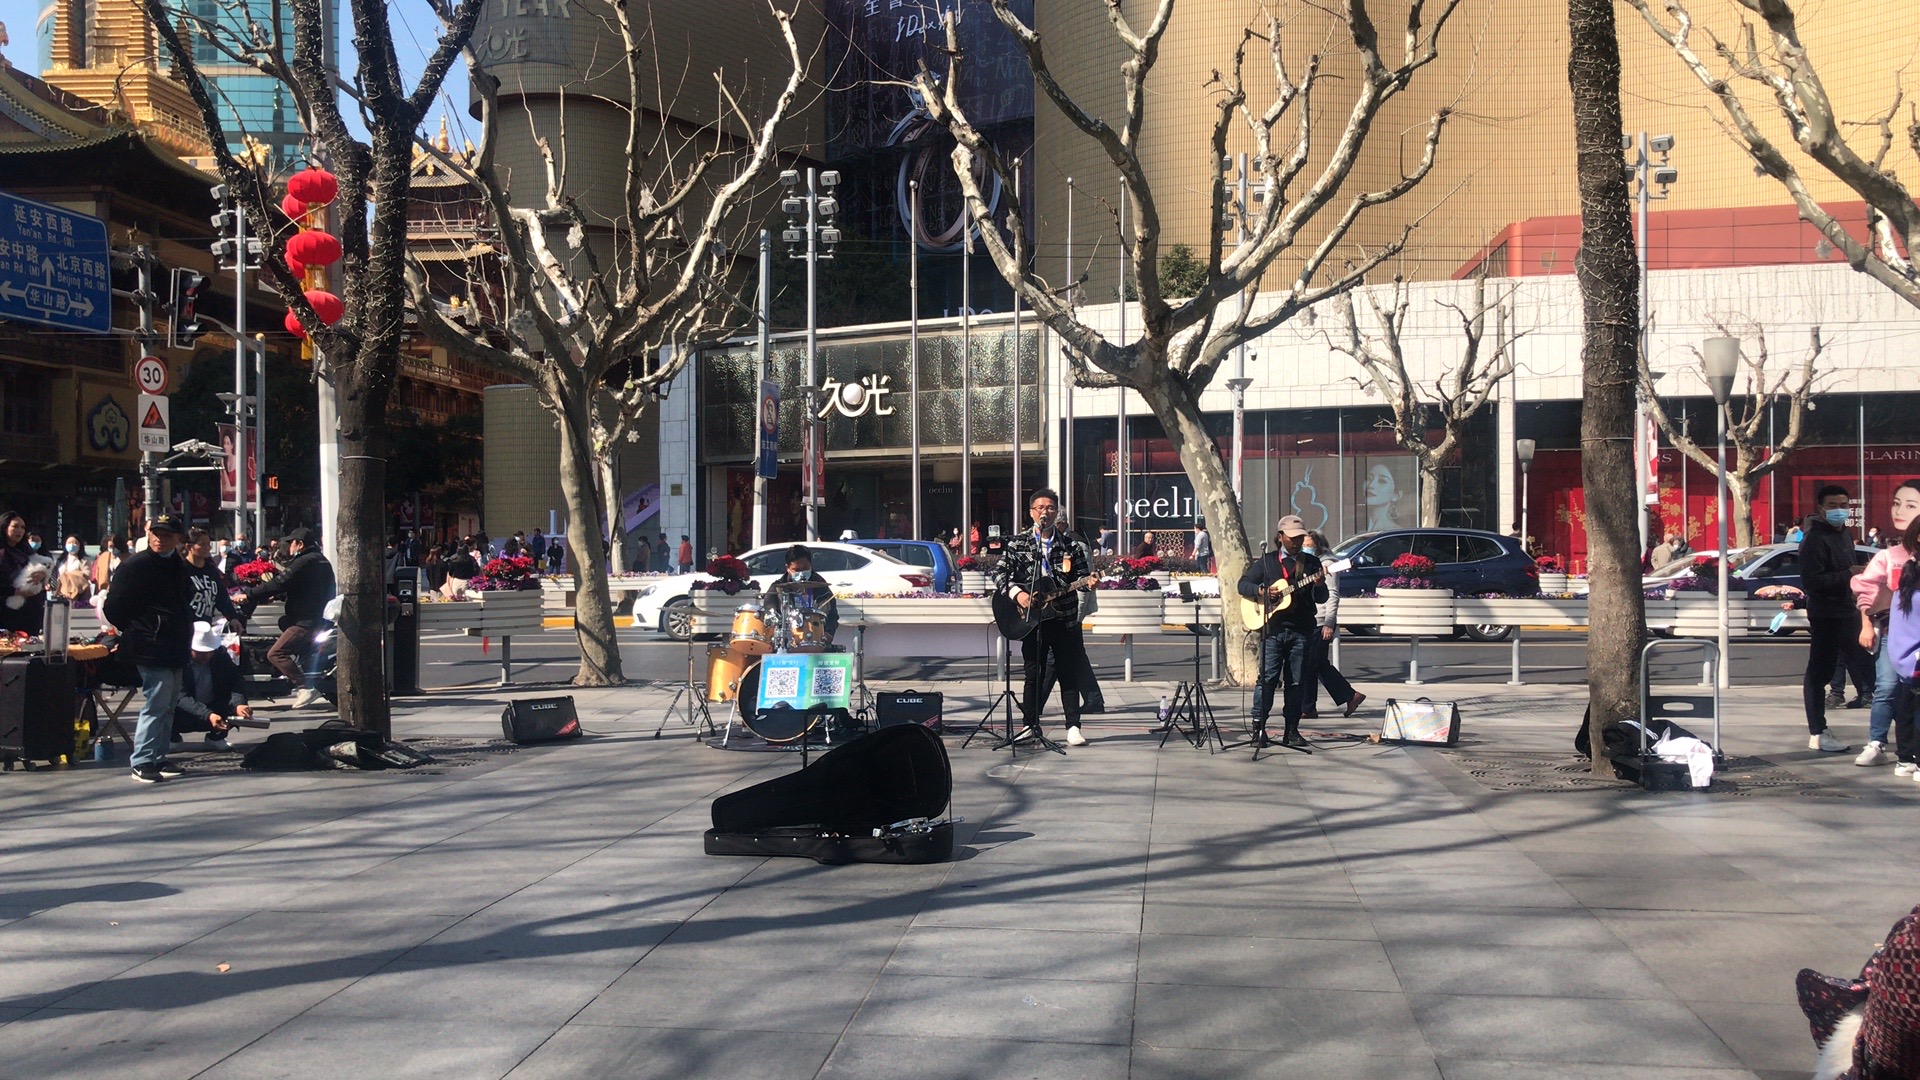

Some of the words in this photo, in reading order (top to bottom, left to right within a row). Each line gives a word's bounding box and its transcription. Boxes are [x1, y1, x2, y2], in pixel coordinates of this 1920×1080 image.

[13, 204, 73, 236] 延安西路
[17, 223, 43, 240] Yan'an
[57, 252, 106, 280] 北京西路
[57, 271, 81, 289] Beijing
[30, 288, 66, 311] 华山路
[143, 366, 162, 384] 30
[817, 373, 894, 419] 久光
[531, 702, 559, 711] CUBE
